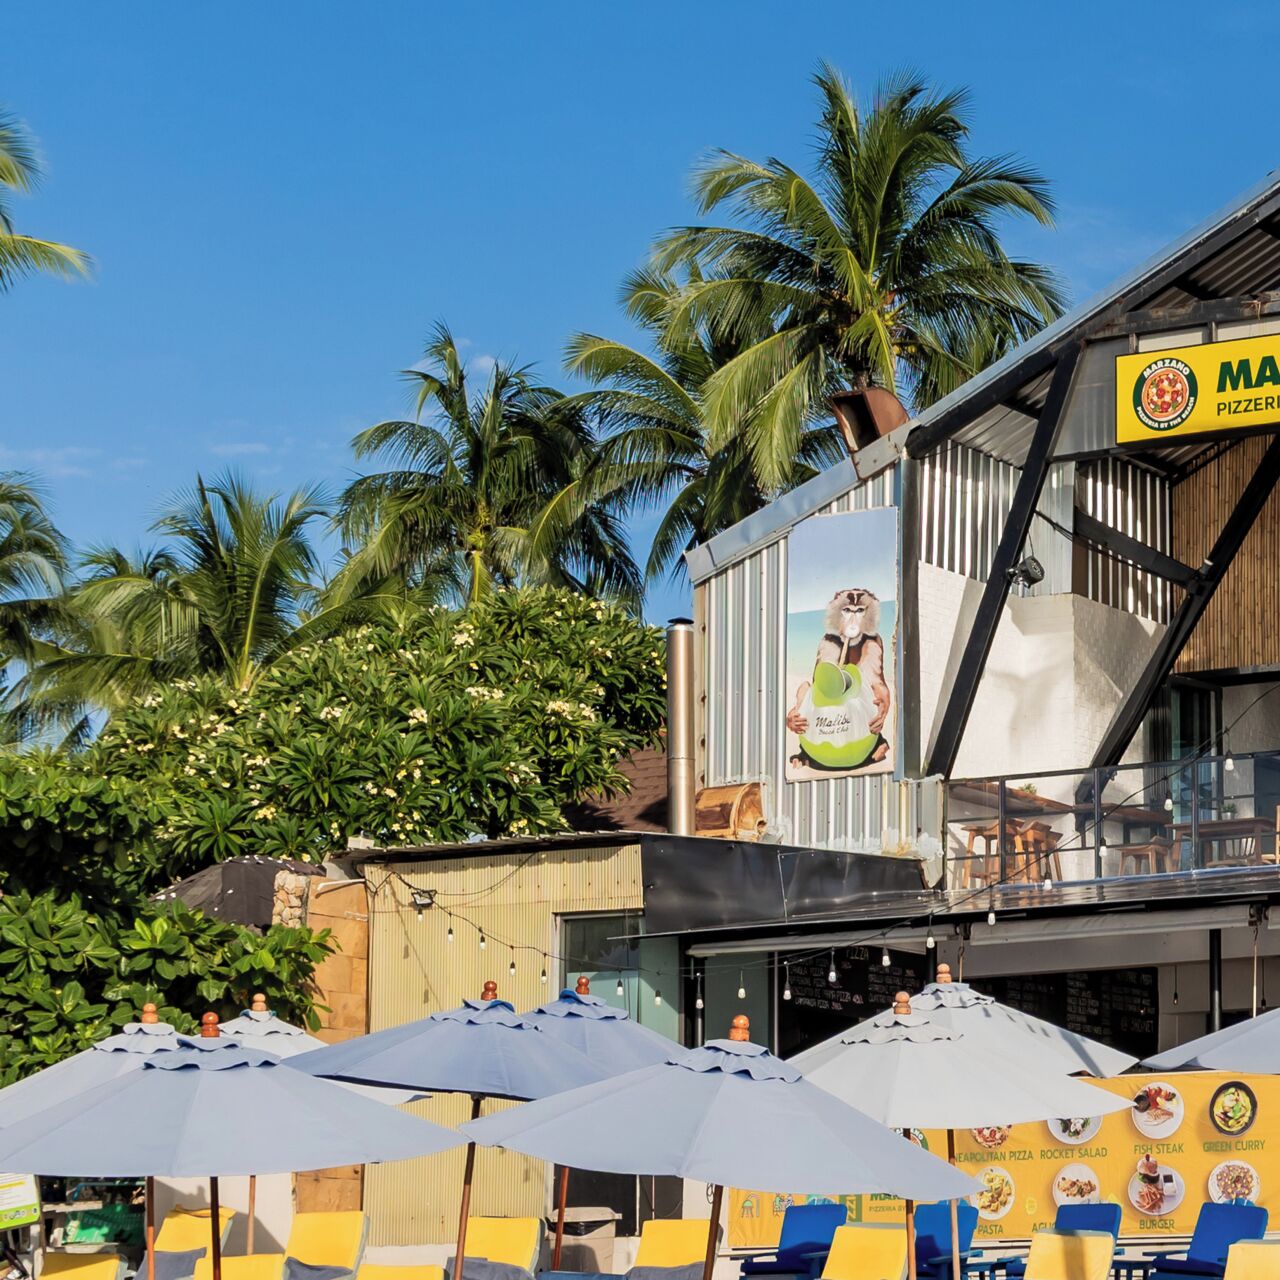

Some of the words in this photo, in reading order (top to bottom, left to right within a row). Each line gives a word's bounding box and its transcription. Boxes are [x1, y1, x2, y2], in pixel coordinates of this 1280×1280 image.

[1143, 359, 1190, 379] MARZANO
[1134, 1145, 1152, 1155] FISH
[1156, 1143, 1184, 1154] STEAK
[1203, 1141, 1232, 1152] GREEN
[1235, 1140, 1266, 1151] CURRY
[1009, 1150, 1034, 1160] PIZZA
[1040, 1148, 1075, 1160] ROCKET
[1078, 1147, 1108, 1158] SALAD
[977, 1224, 1004, 1234] PASTA
[1139, 1219, 1175, 1230] BURGER
